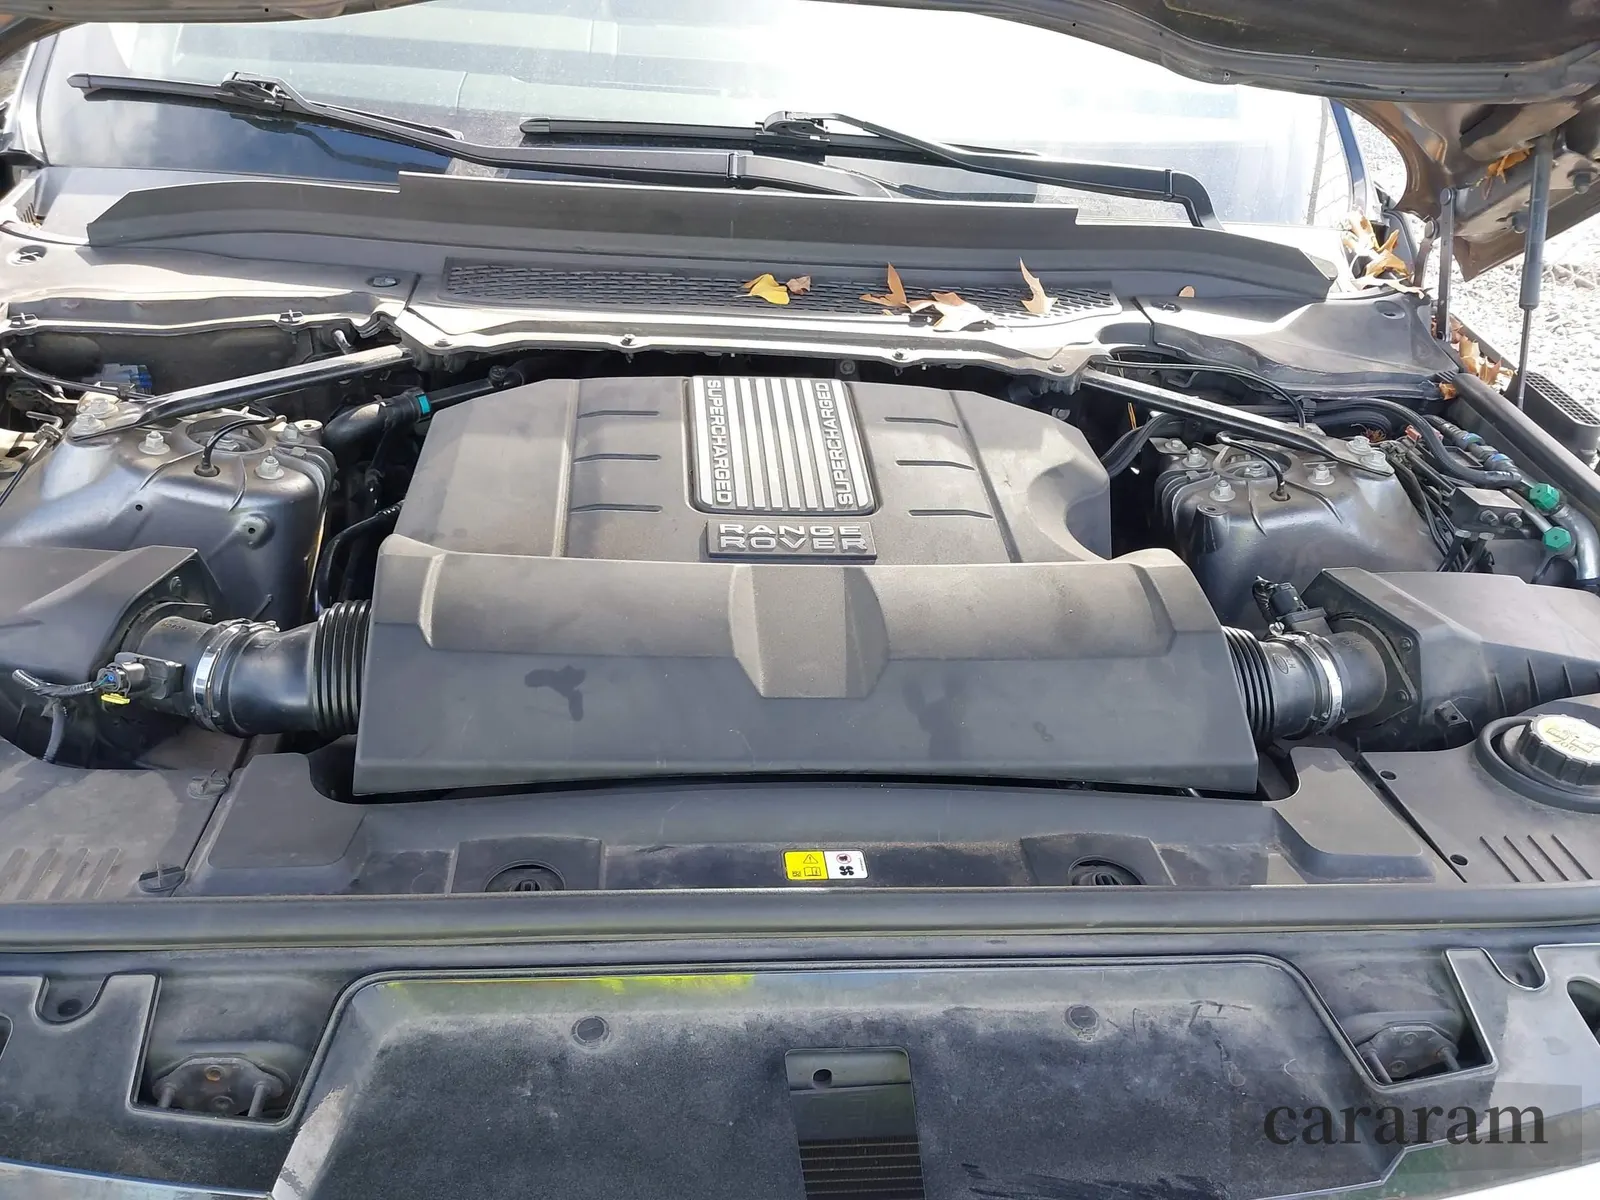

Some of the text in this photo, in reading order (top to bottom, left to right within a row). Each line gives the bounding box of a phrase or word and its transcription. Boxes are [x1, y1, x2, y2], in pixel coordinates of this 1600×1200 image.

[707, 379, 732, 505] SUPERCHARGED
[816, 382, 853, 505] SUPERCHARGED
[719, 523, 862, 537] RANGE
[720, 537, 868, 551] ROVER
